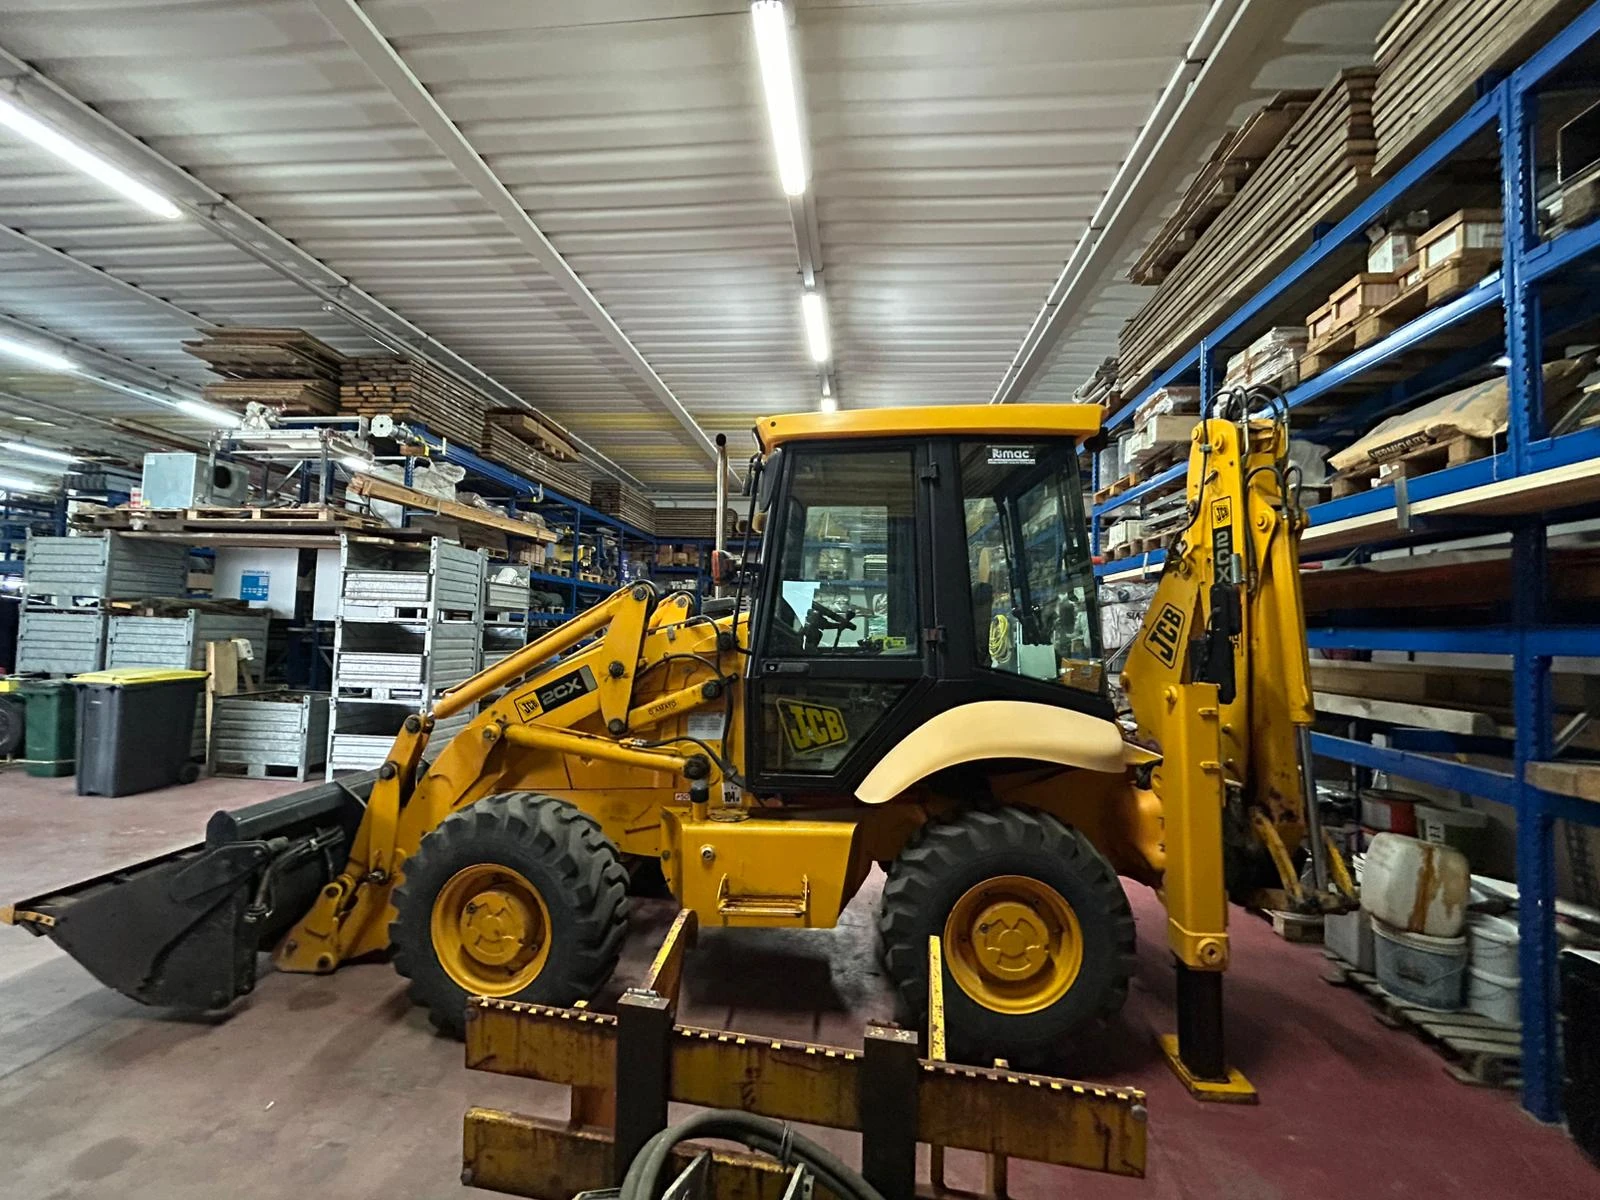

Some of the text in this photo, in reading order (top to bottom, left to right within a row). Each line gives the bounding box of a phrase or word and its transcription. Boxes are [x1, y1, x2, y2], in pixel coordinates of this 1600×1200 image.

[1215, 530, 1231, 584] 2CX
[1149, 608, 1182, 662] JCB
[521, 677, 582, 714] JCB 2CX
[788, 704, 844, 749] JCB
